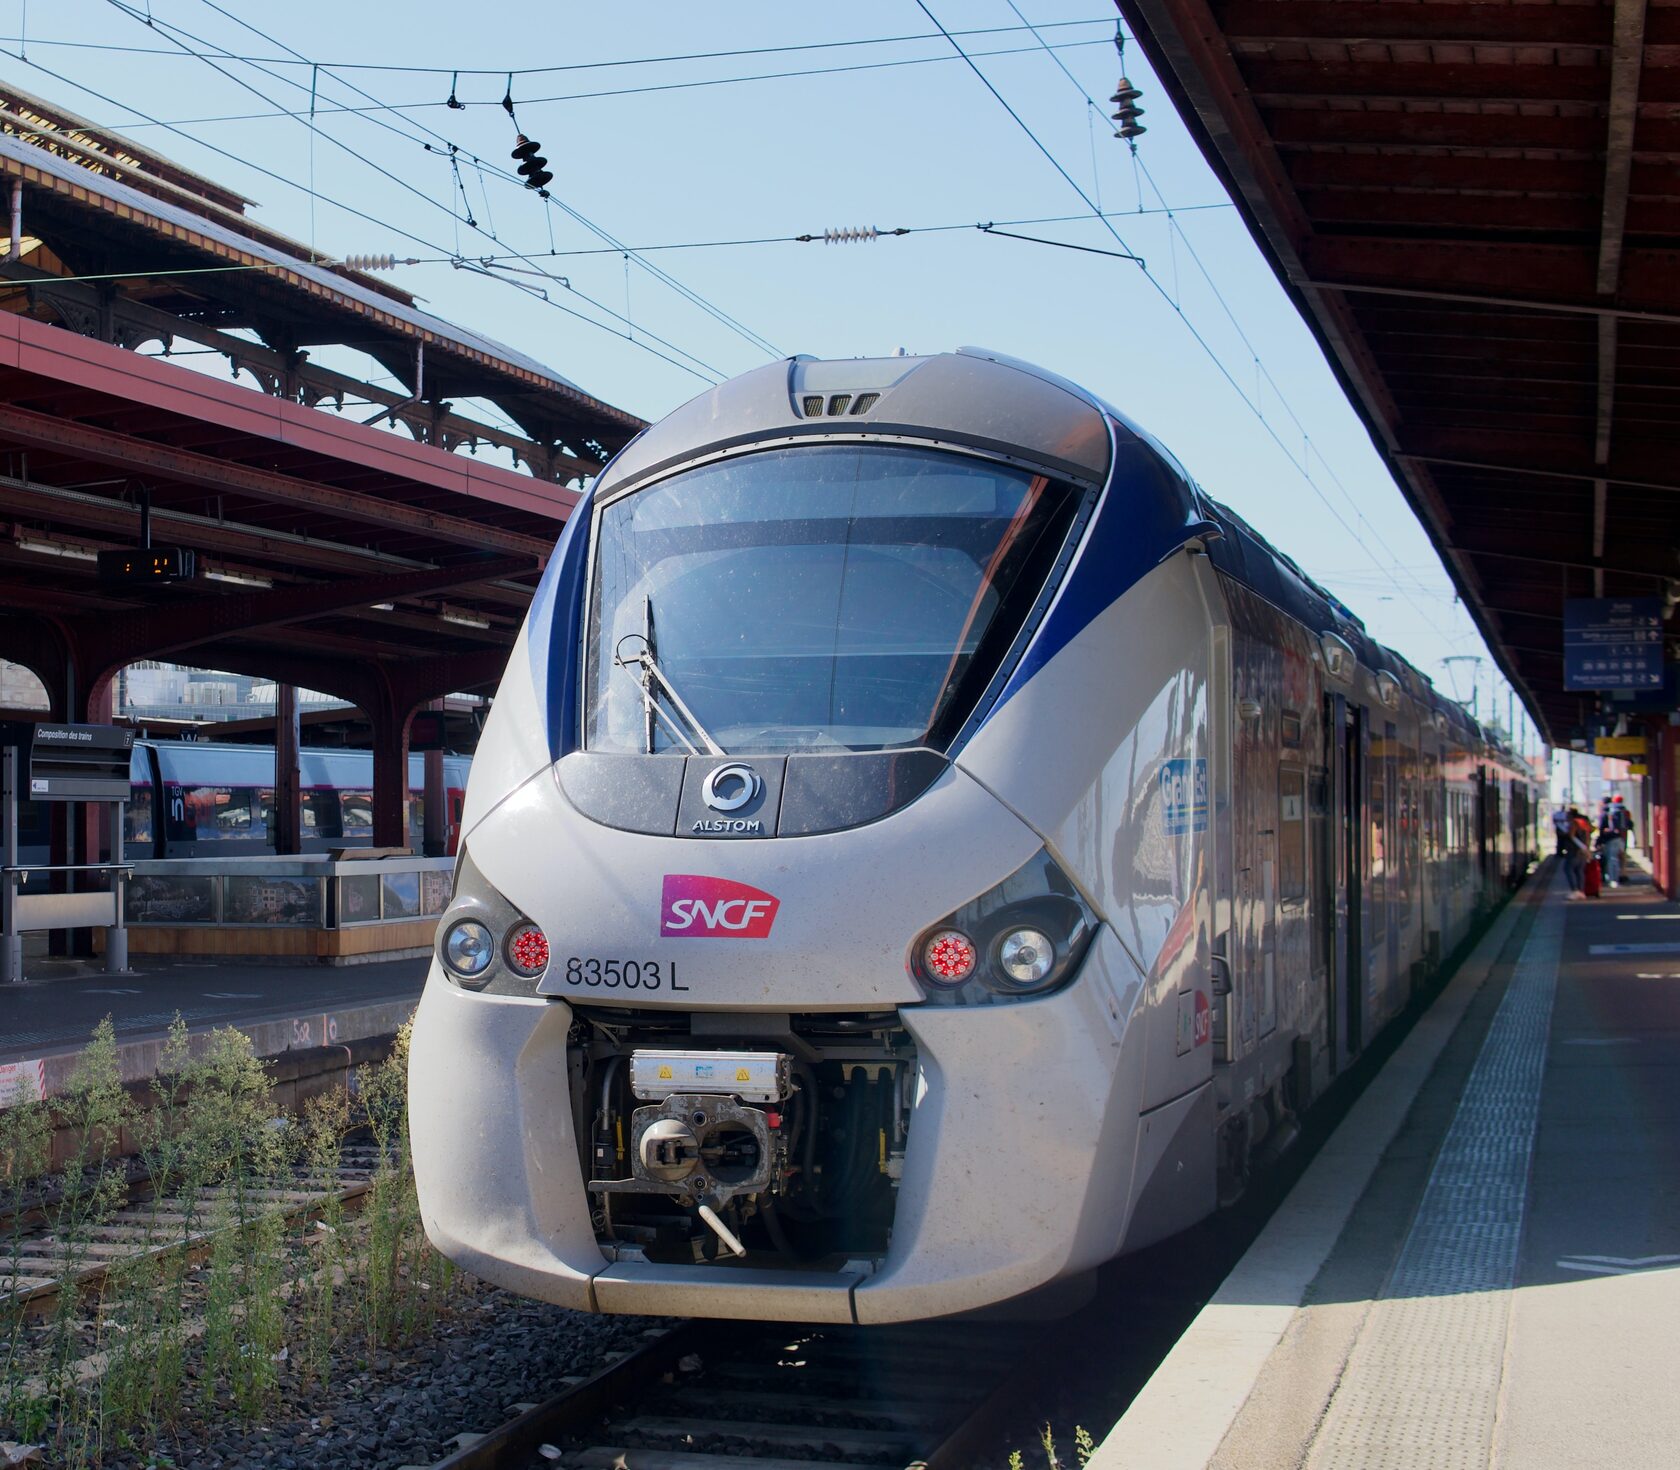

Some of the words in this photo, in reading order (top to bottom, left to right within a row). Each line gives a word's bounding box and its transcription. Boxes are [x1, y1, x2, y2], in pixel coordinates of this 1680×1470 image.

[37, 728, 68, 740] Composition
[69, 731, 78, 739] des
[79, 732, 92, 741] trains
[692, 820, 760, 832] ALSTOM
[665, 899, 771, 930] SNCF
[565, 957, 661, 990] 83503
[671, 962, 689, 991] L
